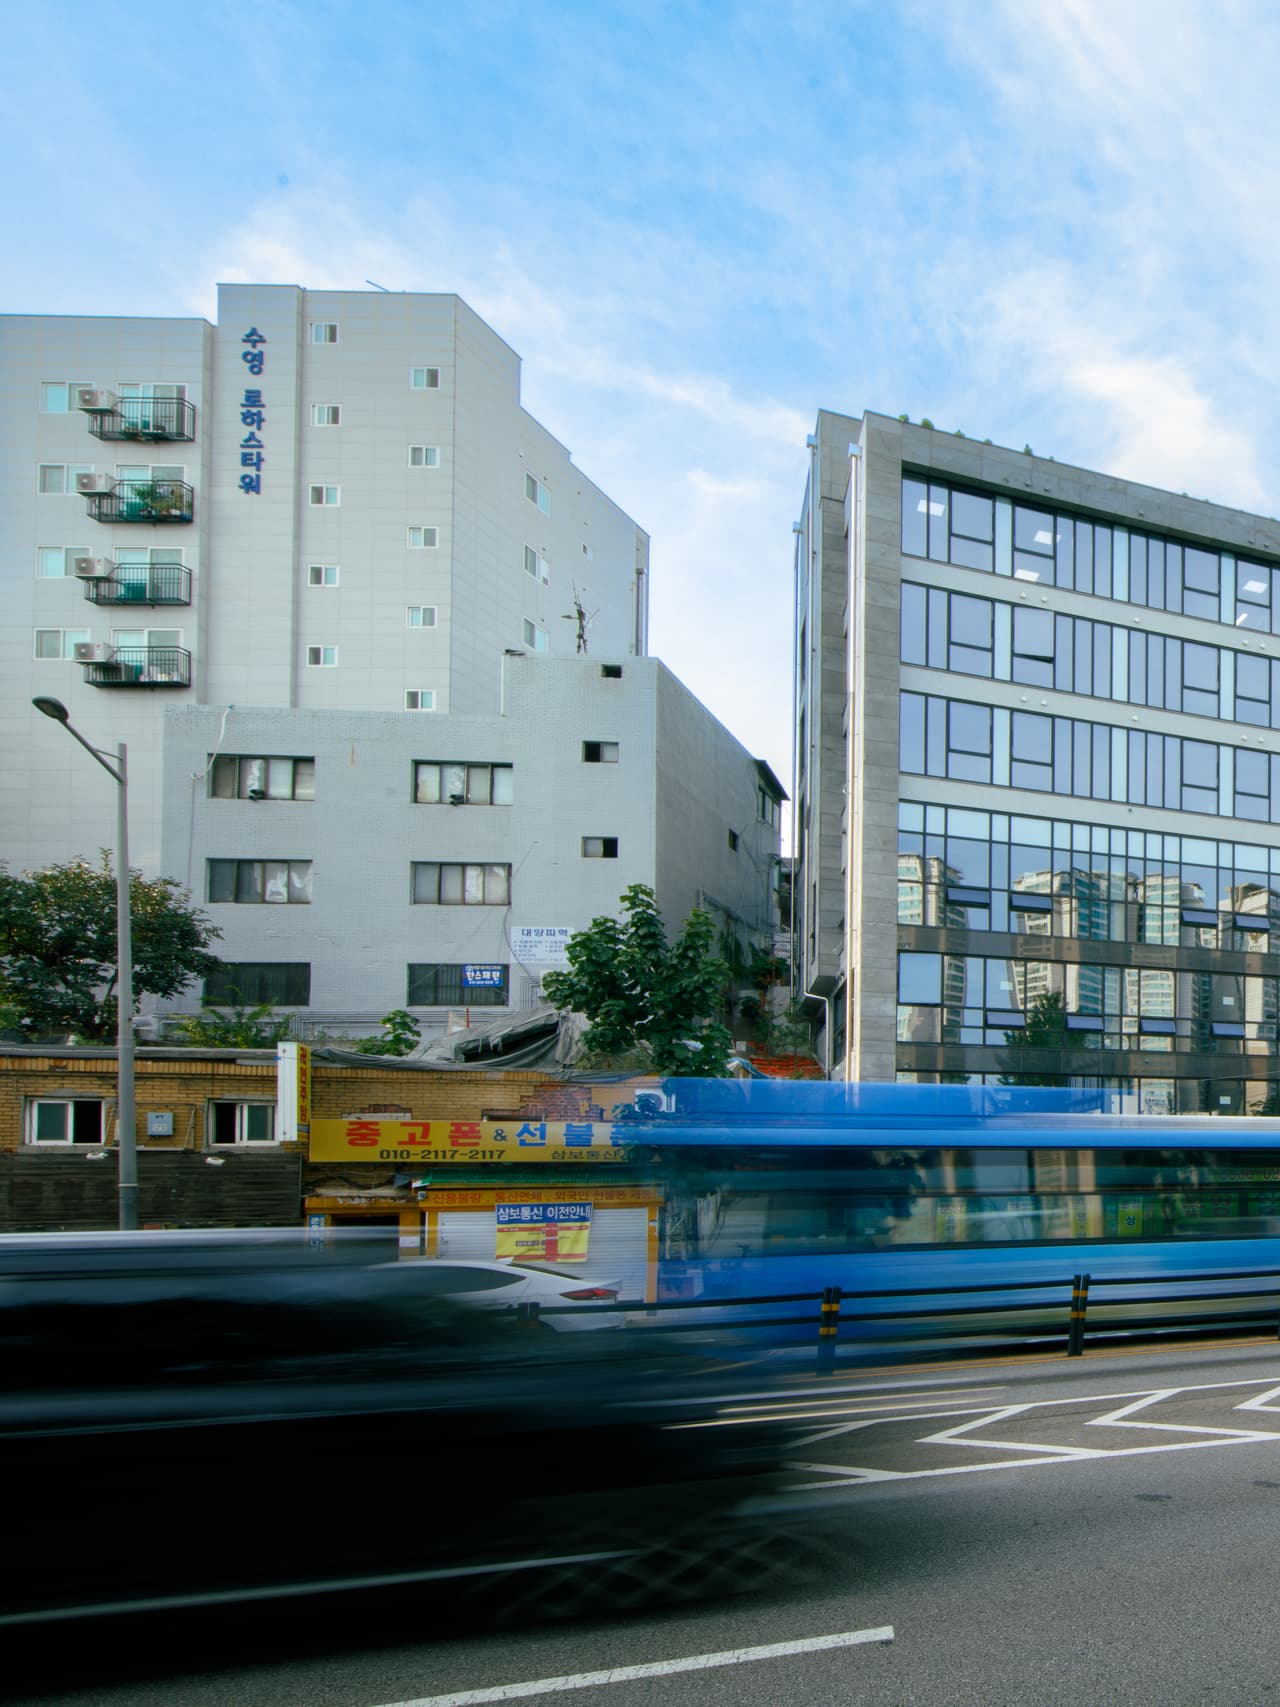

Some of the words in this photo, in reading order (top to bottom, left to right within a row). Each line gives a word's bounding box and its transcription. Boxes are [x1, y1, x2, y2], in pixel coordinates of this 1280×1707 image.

[241, 327, 267, 376] 수영
[238, 389, 266, 495] 로하스타워
[345, 1121, 482, 1147] 중고폰
[493, 1128, 508, 1142] &
[379, 1149, 507, 1161] 010-2117-2117
[497, 1206, 543, 1221] 삼보통신
[547, 1204, 592, 1220] 이전안내
